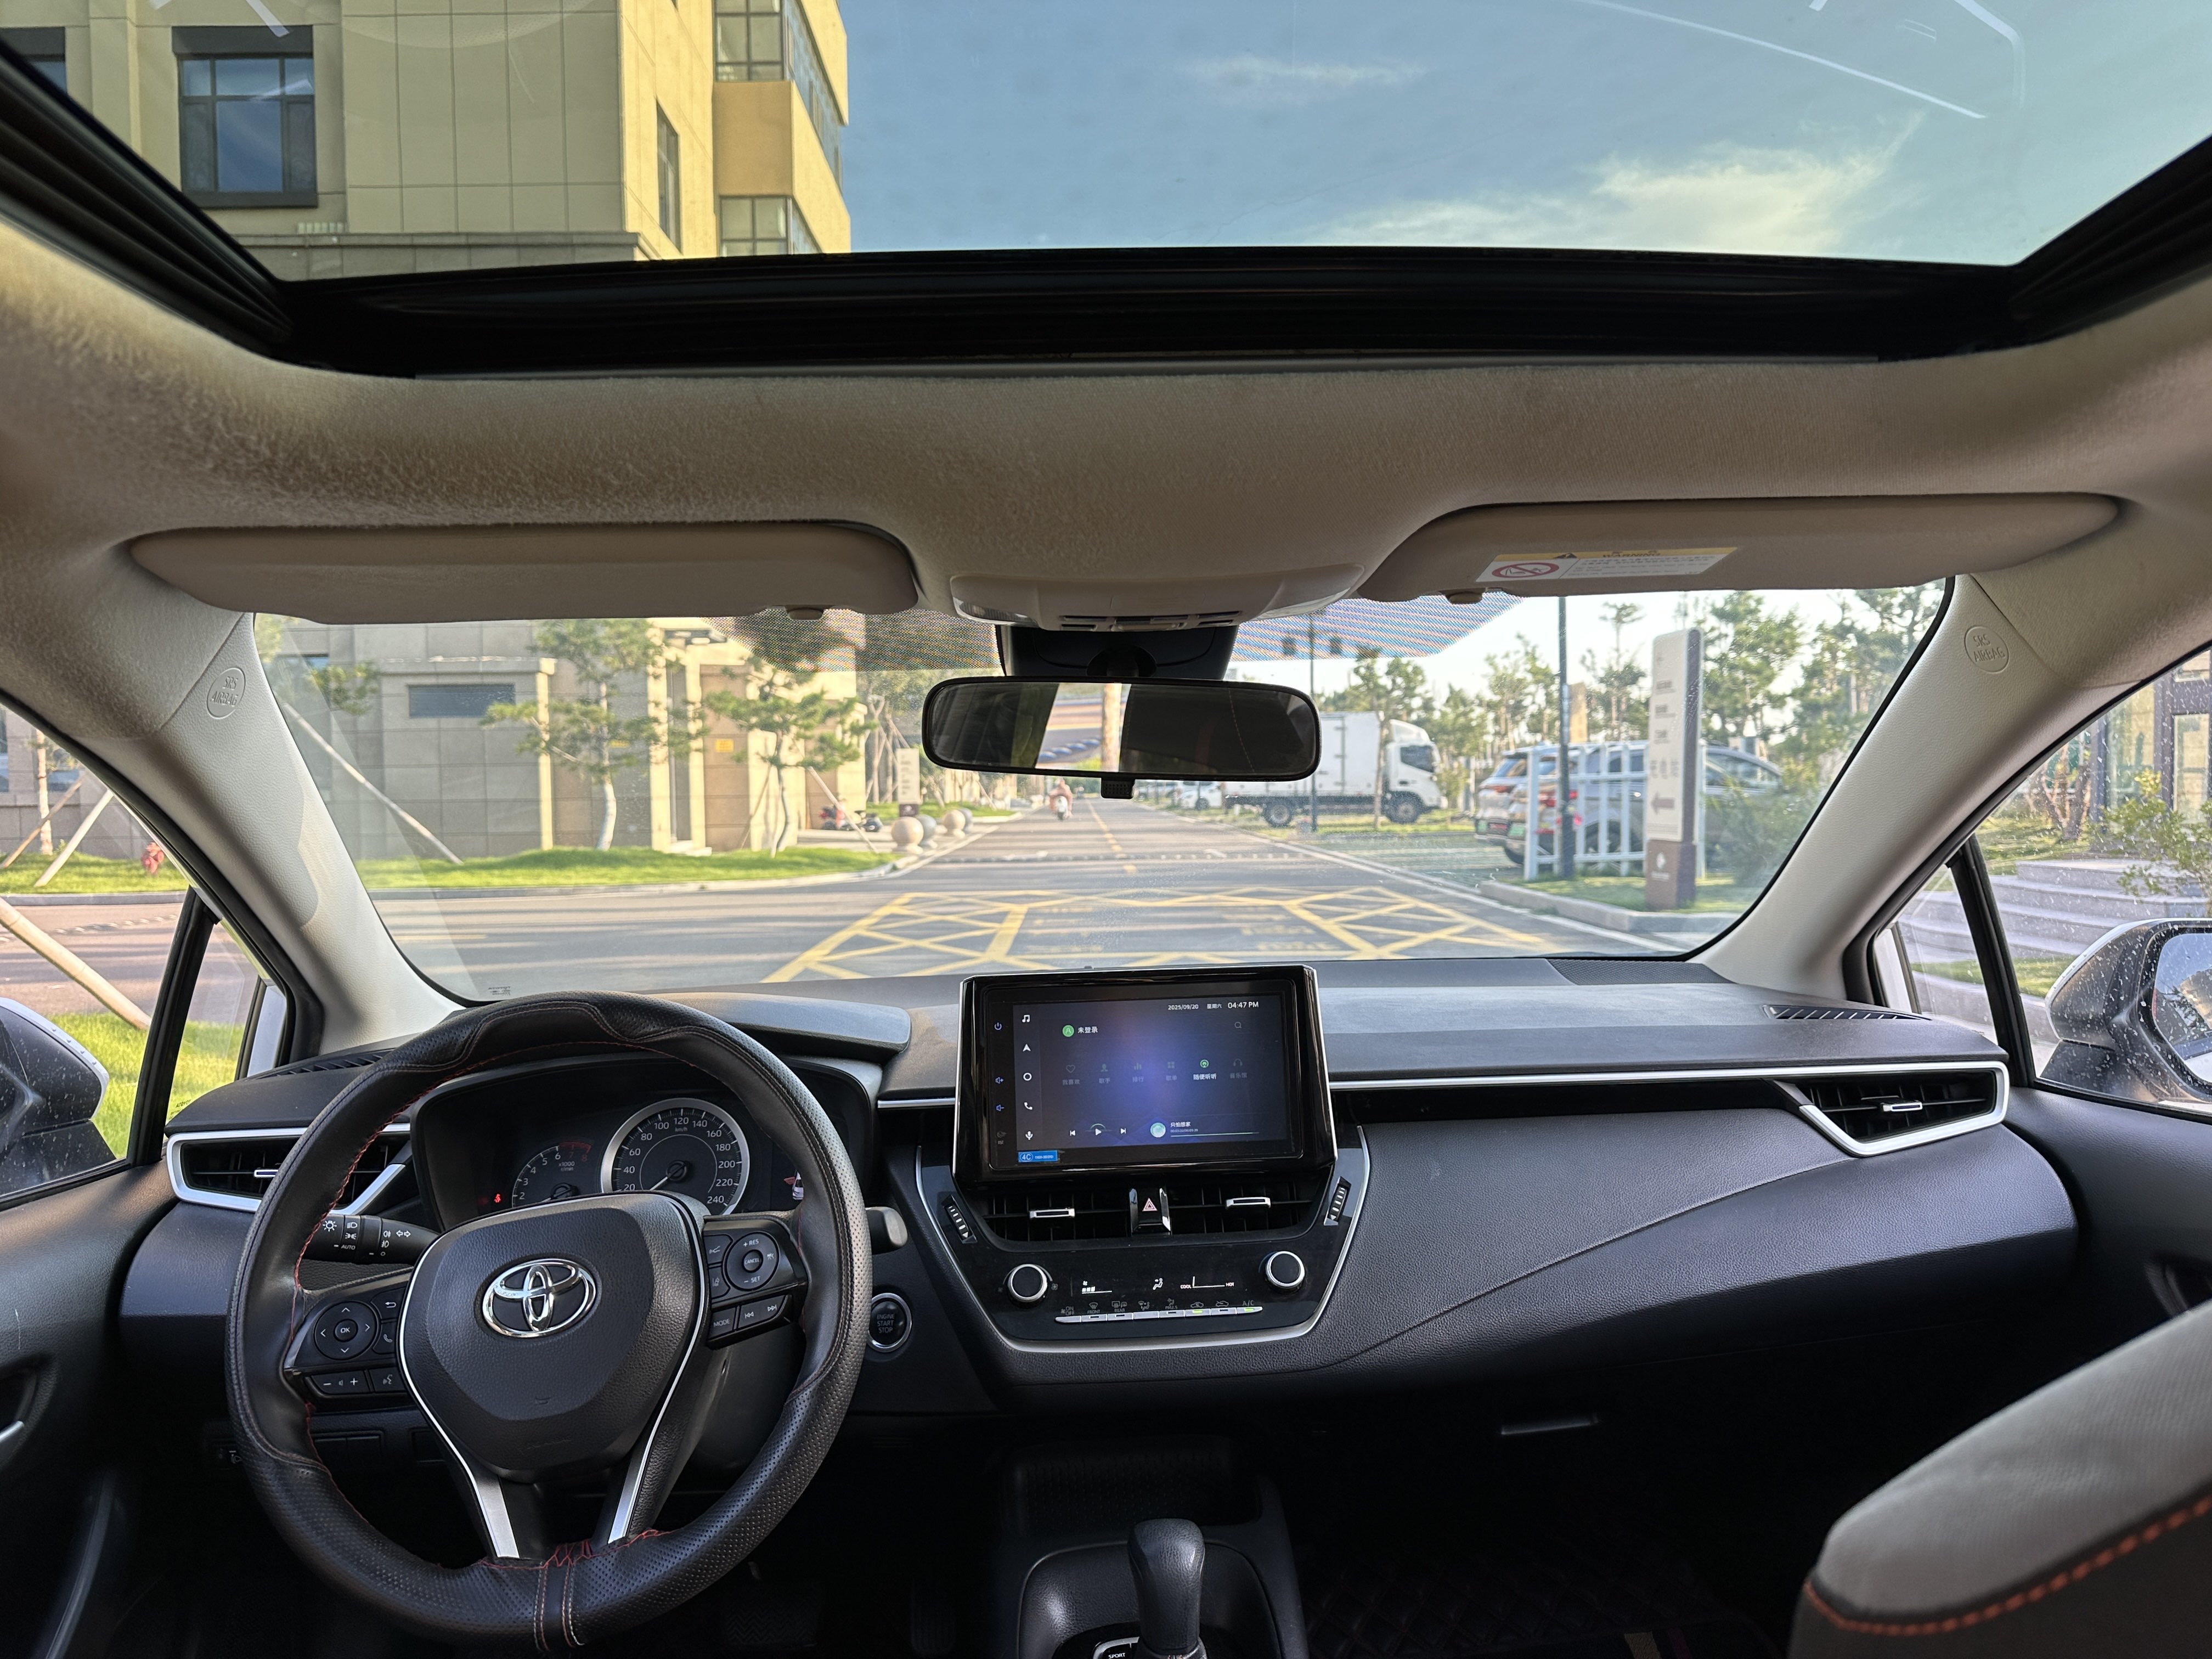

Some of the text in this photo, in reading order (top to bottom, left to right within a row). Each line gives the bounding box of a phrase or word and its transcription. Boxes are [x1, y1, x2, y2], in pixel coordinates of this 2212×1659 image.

[1973, 634, 1991, 647] SRS
[1973, 647, 2006, 663] AIRBAG
[222, 676, 239, 690] SRS
[692, 1120, 708, 1128] 140
[641, 1132, 653, 1141] 80
[629, 1148, 641, 1156] 60
[623, 1166, 635, 1174] 40
[715, 1178, 733, 1187] 220
[707, 1195, 724, 1204] 240
[713, 1318, 731, 1328] MODE
